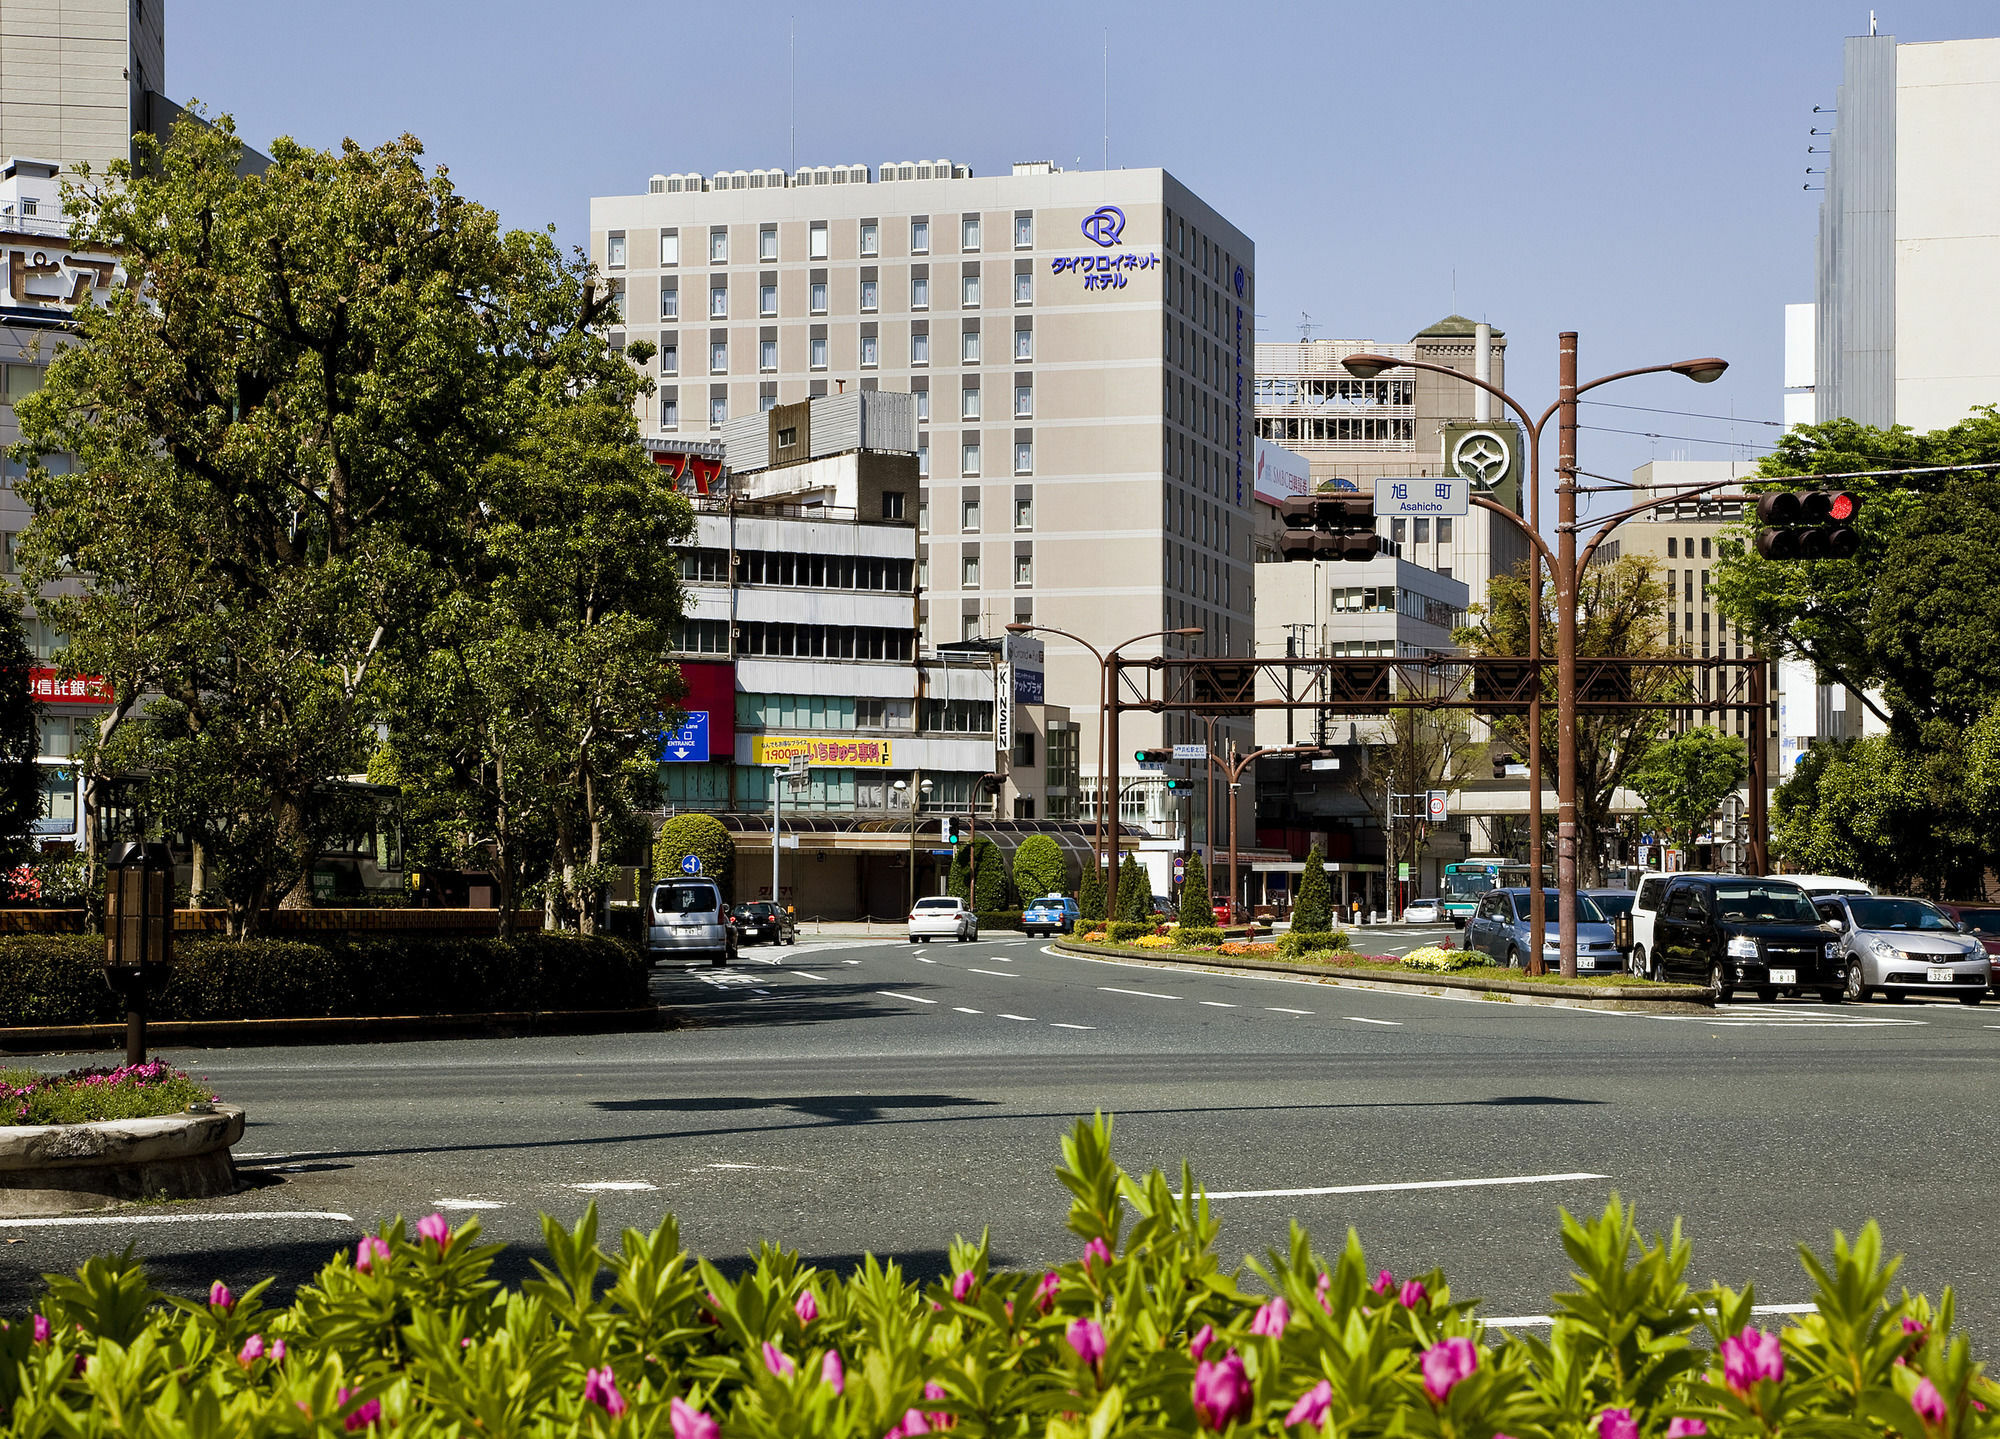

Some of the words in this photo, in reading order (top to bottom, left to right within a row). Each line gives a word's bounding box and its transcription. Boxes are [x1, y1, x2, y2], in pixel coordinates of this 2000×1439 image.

[1051, 252, 1160, 275] ダイワロイネット
[1084, 272, 1128, 291] ホテル
[1391, 483, 1452, 499] 旭町
[1400, 502, 1442, 511] Asahicho
[999, 671, 1007, 748] KINSEN
[1432, 802, 1441, 810] 40
